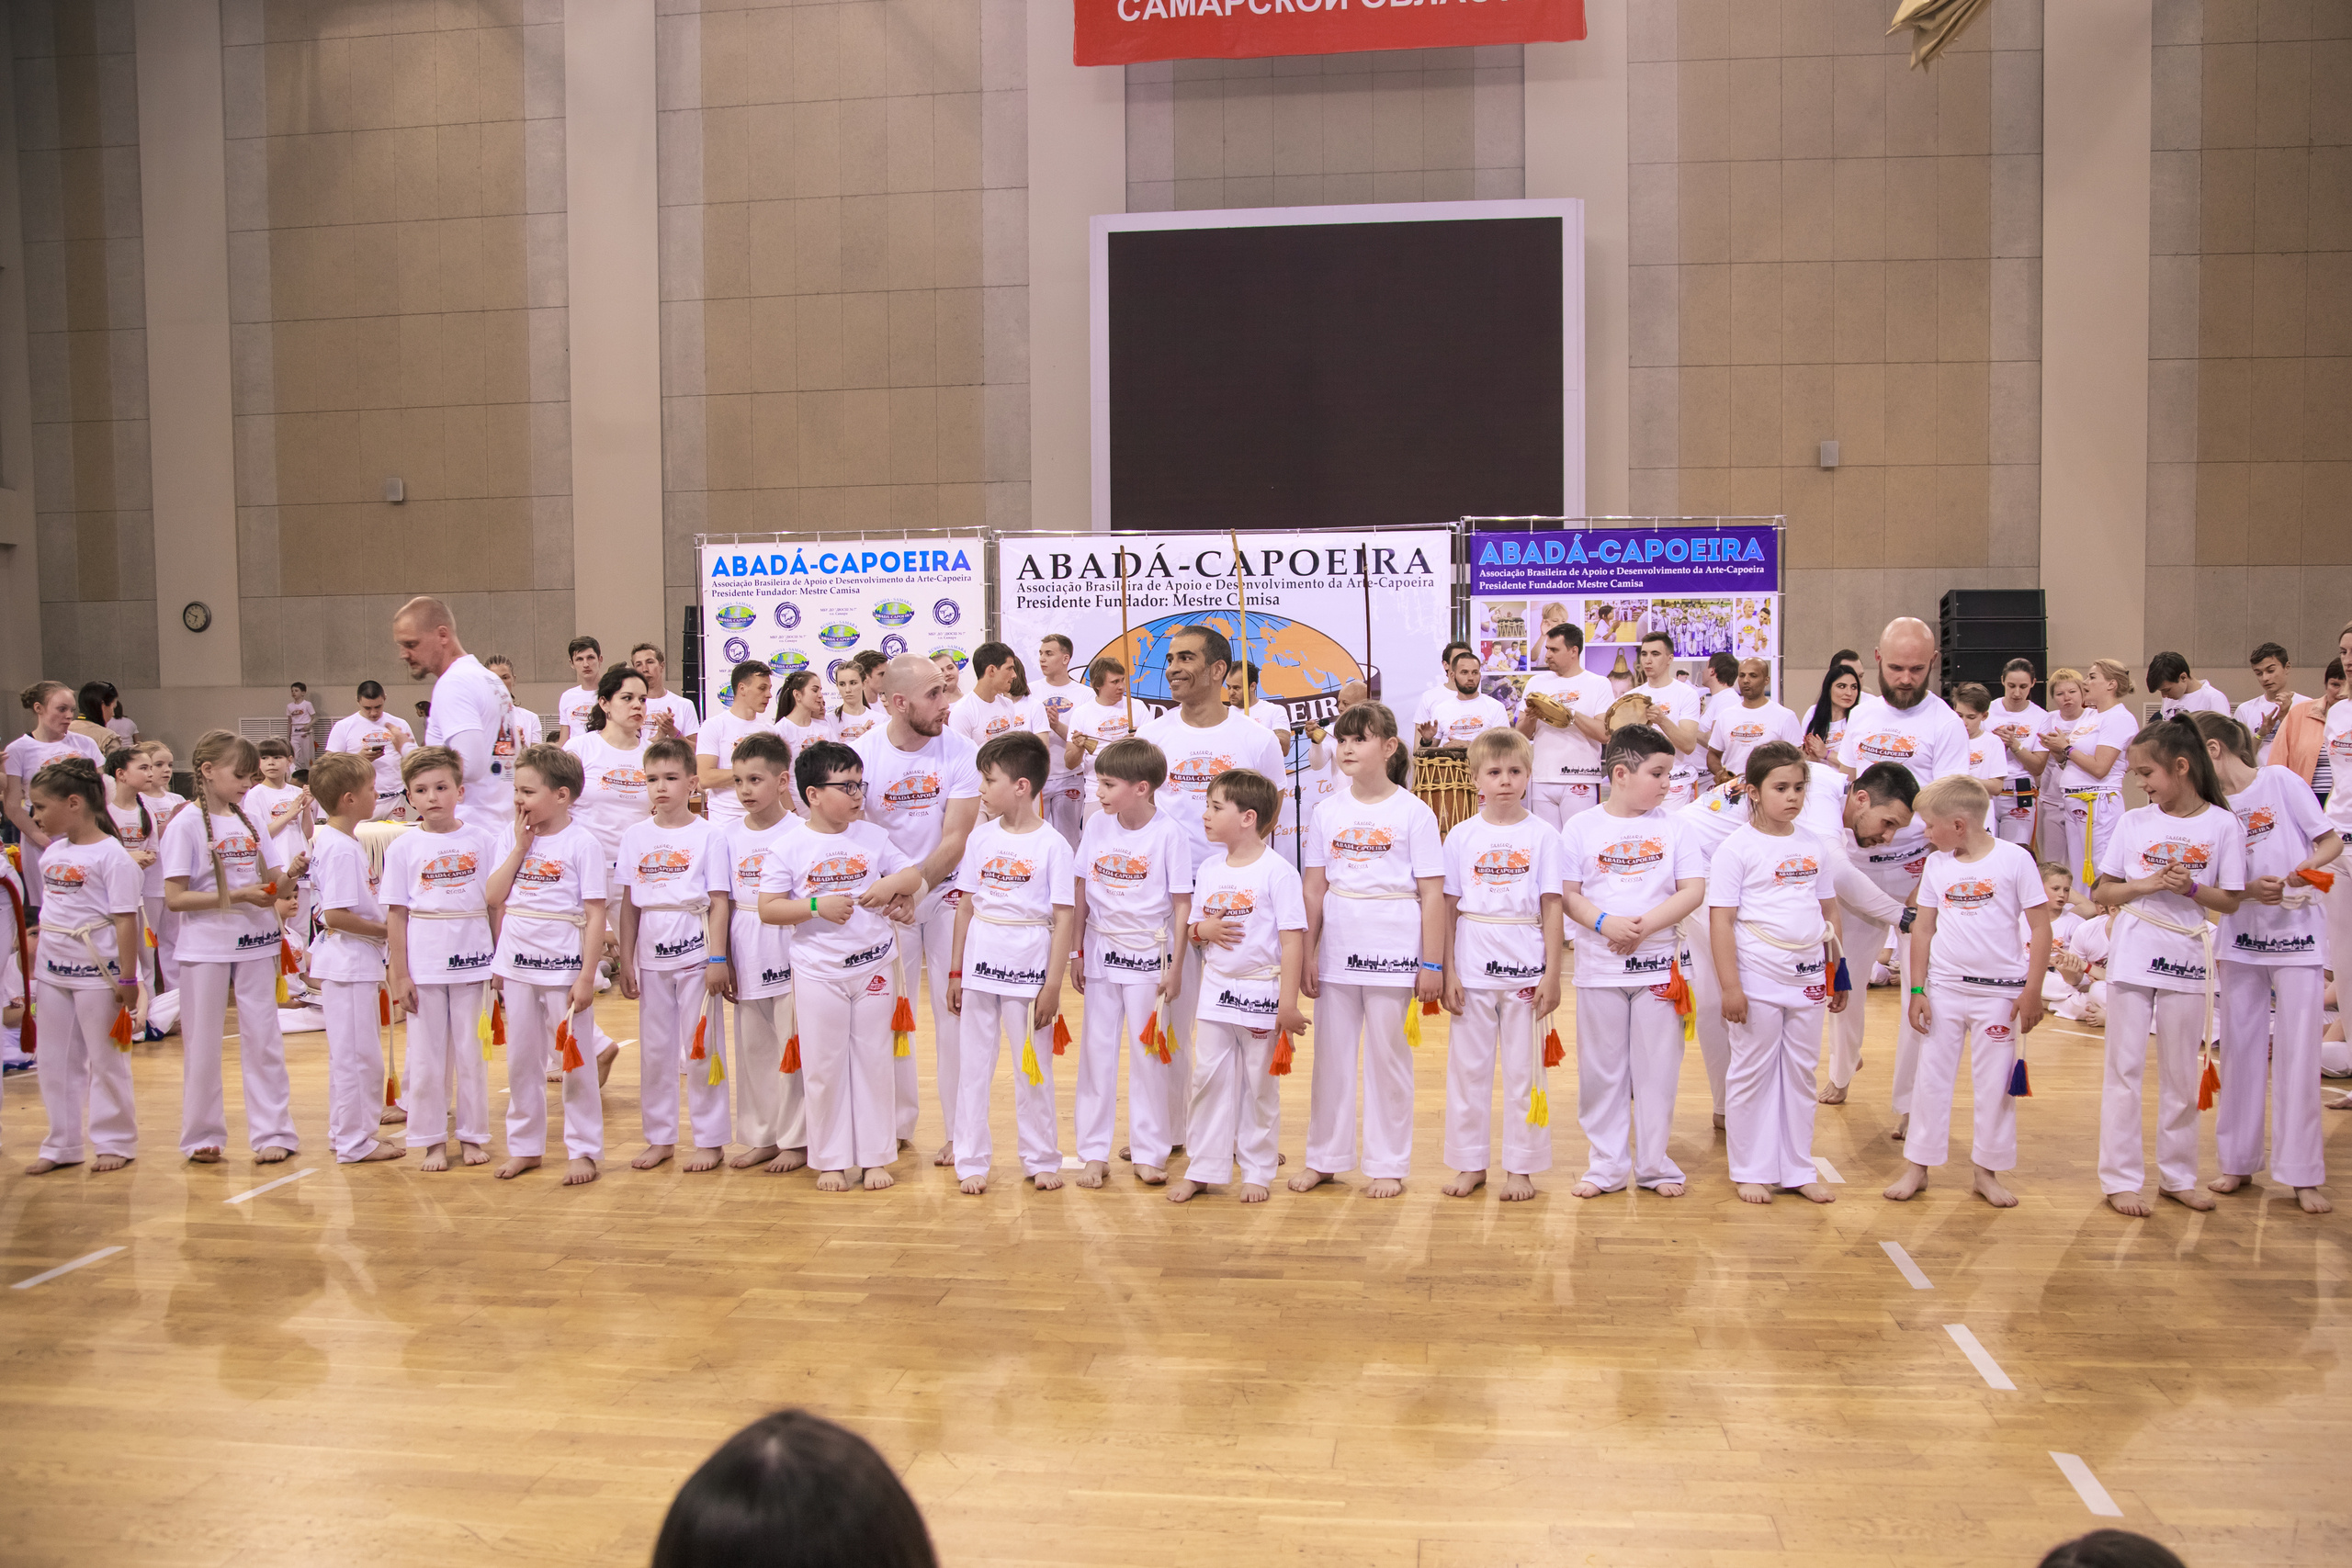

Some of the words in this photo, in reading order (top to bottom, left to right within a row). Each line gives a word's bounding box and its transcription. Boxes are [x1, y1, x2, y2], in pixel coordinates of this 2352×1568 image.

[1478, 534, 1765, 565] ABADÁ-CAPOEIRA
[711, 547, 971, 577] ABADÁ-CAPOEIRA
[1016, 544, 1433, 580] ABADÁ-CAPOEIRA
[1479, 570, 1525, 579] Associação
[1527, 568, 1567, 577] Brasileira
[1569, 568, 1579, 576] de
[1582, 568, 1608, 578] Apoio
[1617, 566, 1690, 575] Desenvolvimento
[1692, 566, 1703, 574] da
[1705, 565, 1765, 576] Arte-Capoeira
[712, 580, 752, 588] Associação
[754, 578, 790, 586] Brasileira
[804, 578, 828, 587] Apoio
[835, 576, 903, 585] Desenvolvimento
[917, 574, 971, 583] Arte-Capoeira
[1017, 581, 1081, 595] Associação
[1086, 581, 1143, 592] Brasilira
[1148, 580, 1161, 591] de
[1165, 580, 1202, 593] Apoio
[1205, 582, 1212, 591] e
[1328, 578, 1342, 588] da
[1479, 581, 1527, 590] Presidente
[1529, 581, 1575, 589] Fundador:
[1577, 580, 1608, 588] Mestre
[1611, 579, 1644, 588] Camisa
[756, 588, 797, 596] Fundador:
[799, 587, 828, 595] Mestre
[830, 586, 860, 594] Camisa
[1017, 595, 1091, 608] Presidente
[1173, 593, 1222, 606] Mestre
[1227, 592, 1280, 606] Cmisa
[1602, 855, 1660, 865] ABADÁ-CAPOEIRA
[811, 872, 864, 883] ABADÁ-CAPOEIRA
